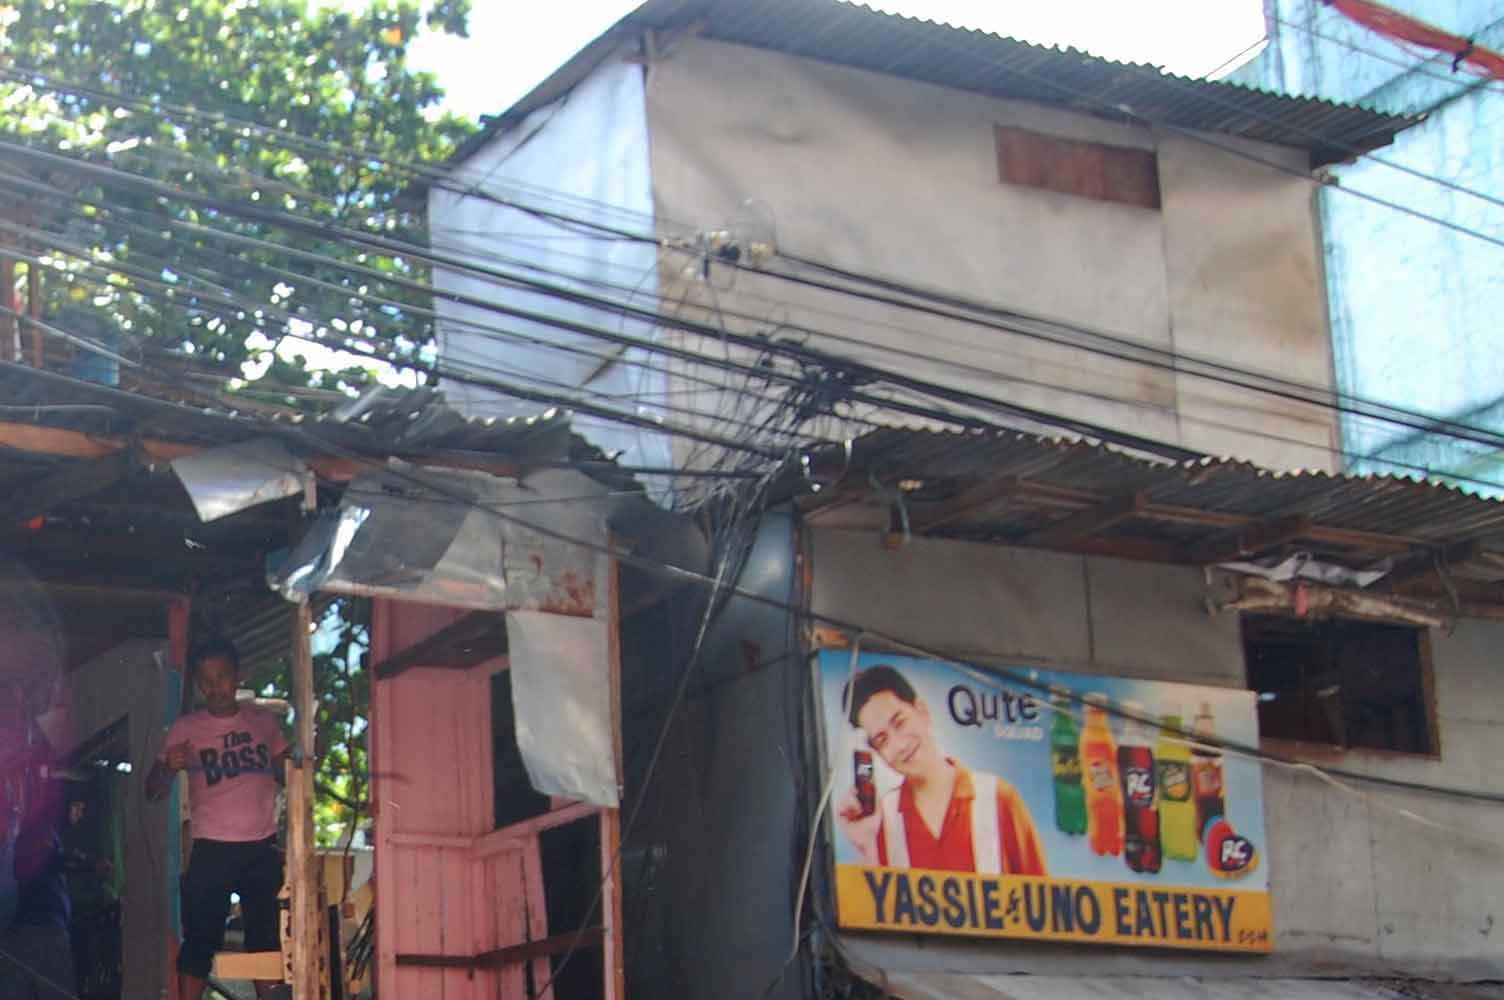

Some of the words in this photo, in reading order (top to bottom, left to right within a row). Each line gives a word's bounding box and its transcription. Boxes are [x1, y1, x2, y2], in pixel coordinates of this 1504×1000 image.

[947, 685, 1038, 727] Qute
[217, 730, 252, 749] The
[199, 744, 268, 786] BOSS
[1221, 839, 1249, 863] RC
[864, 870, 1004, 929] YASSIE
[1023, 881, 1102, 934] UNO
[1112, 887, 1235, 942] EATERY
